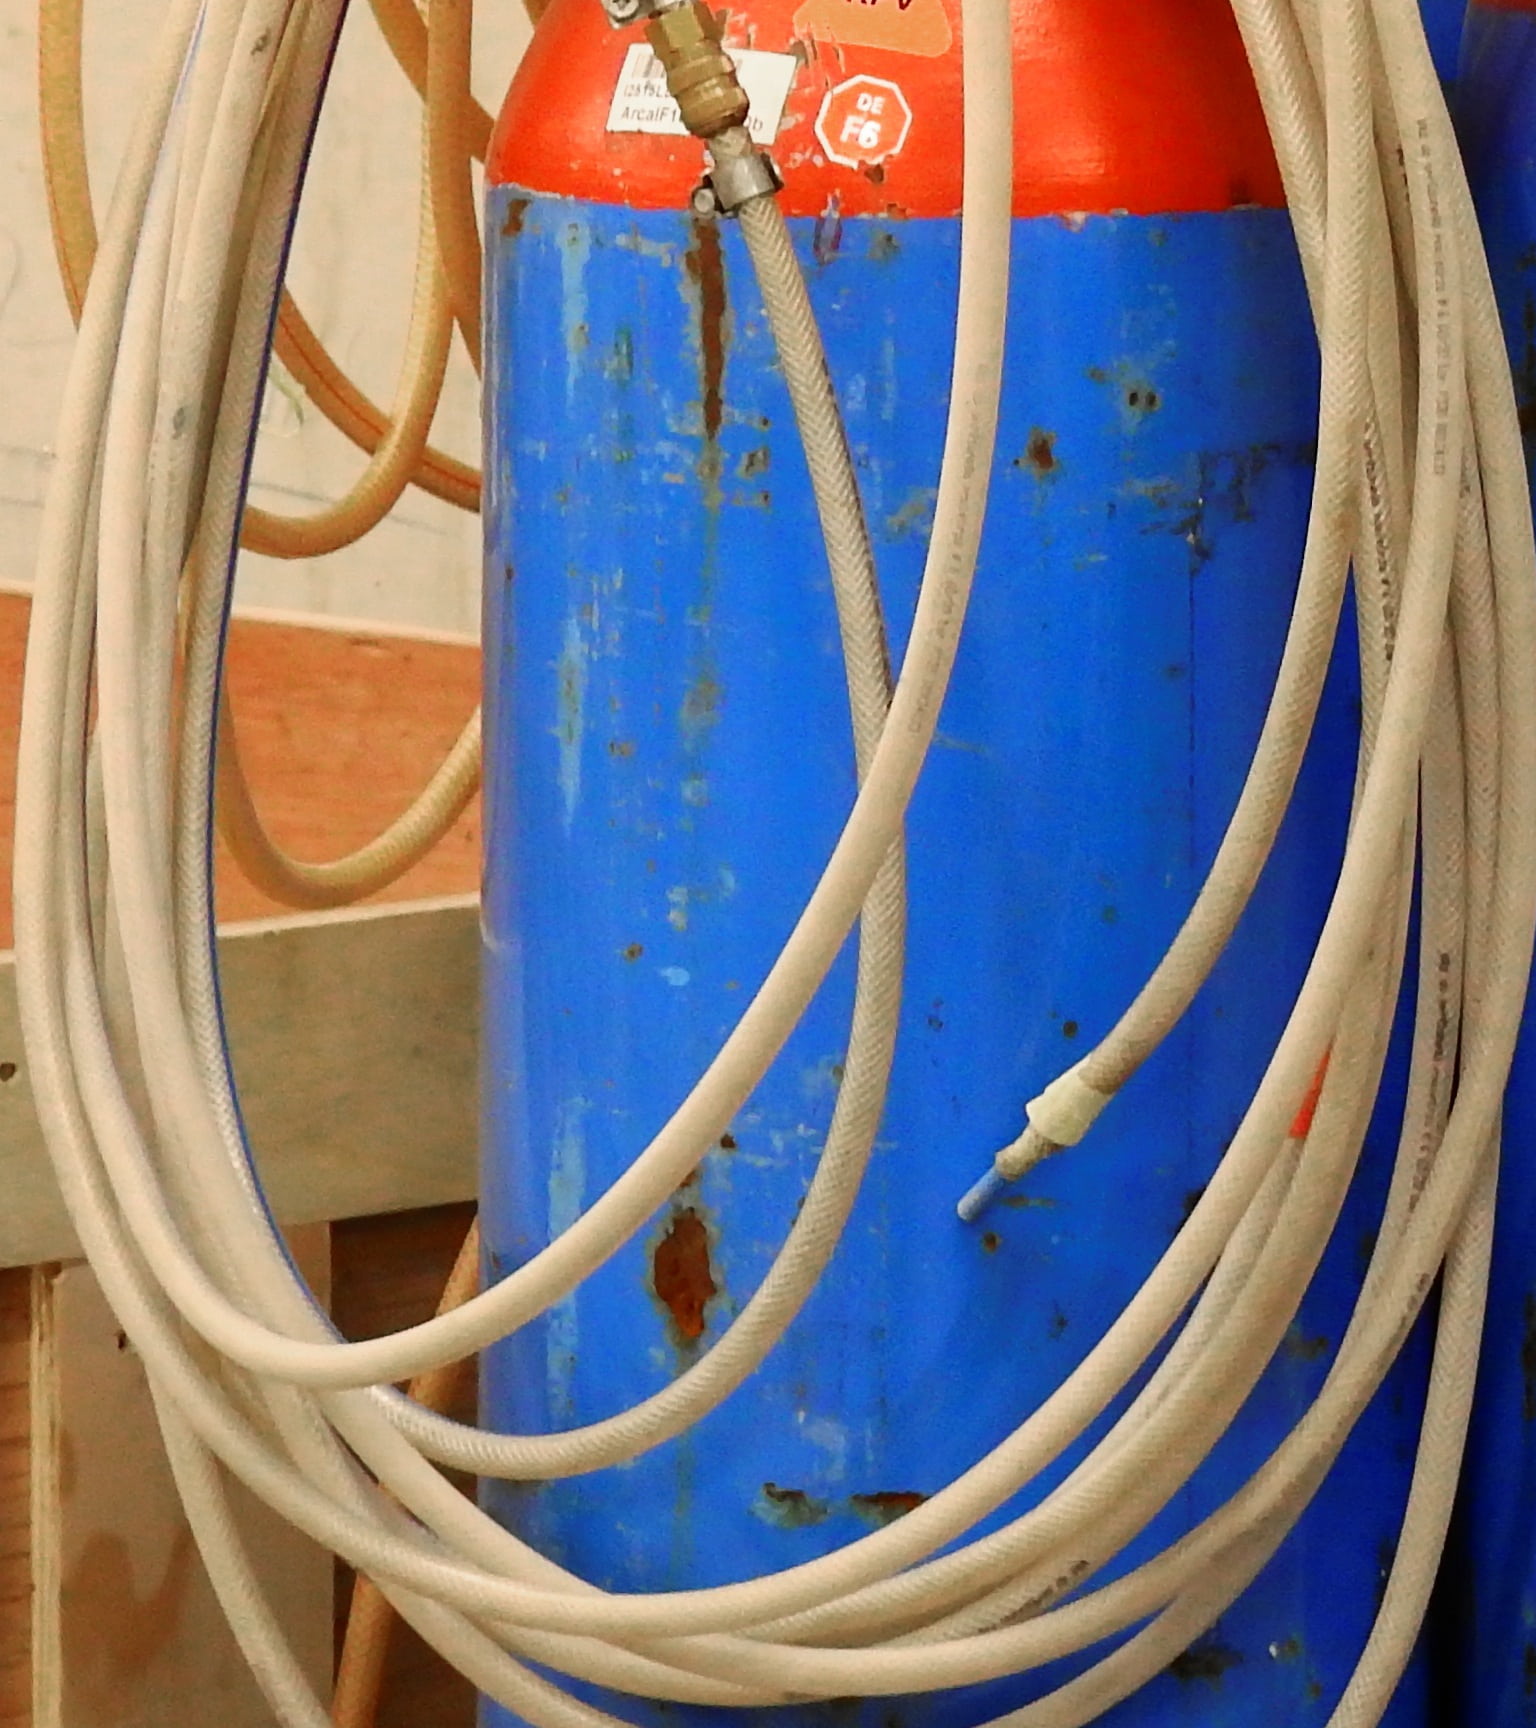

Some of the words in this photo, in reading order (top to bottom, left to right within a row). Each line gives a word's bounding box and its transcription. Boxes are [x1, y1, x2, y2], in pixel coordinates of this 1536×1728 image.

[620, 105, 680, 123] ArcalF1
[855, 92, 887, 115] DE
[839, 115, 883, 150] F6
